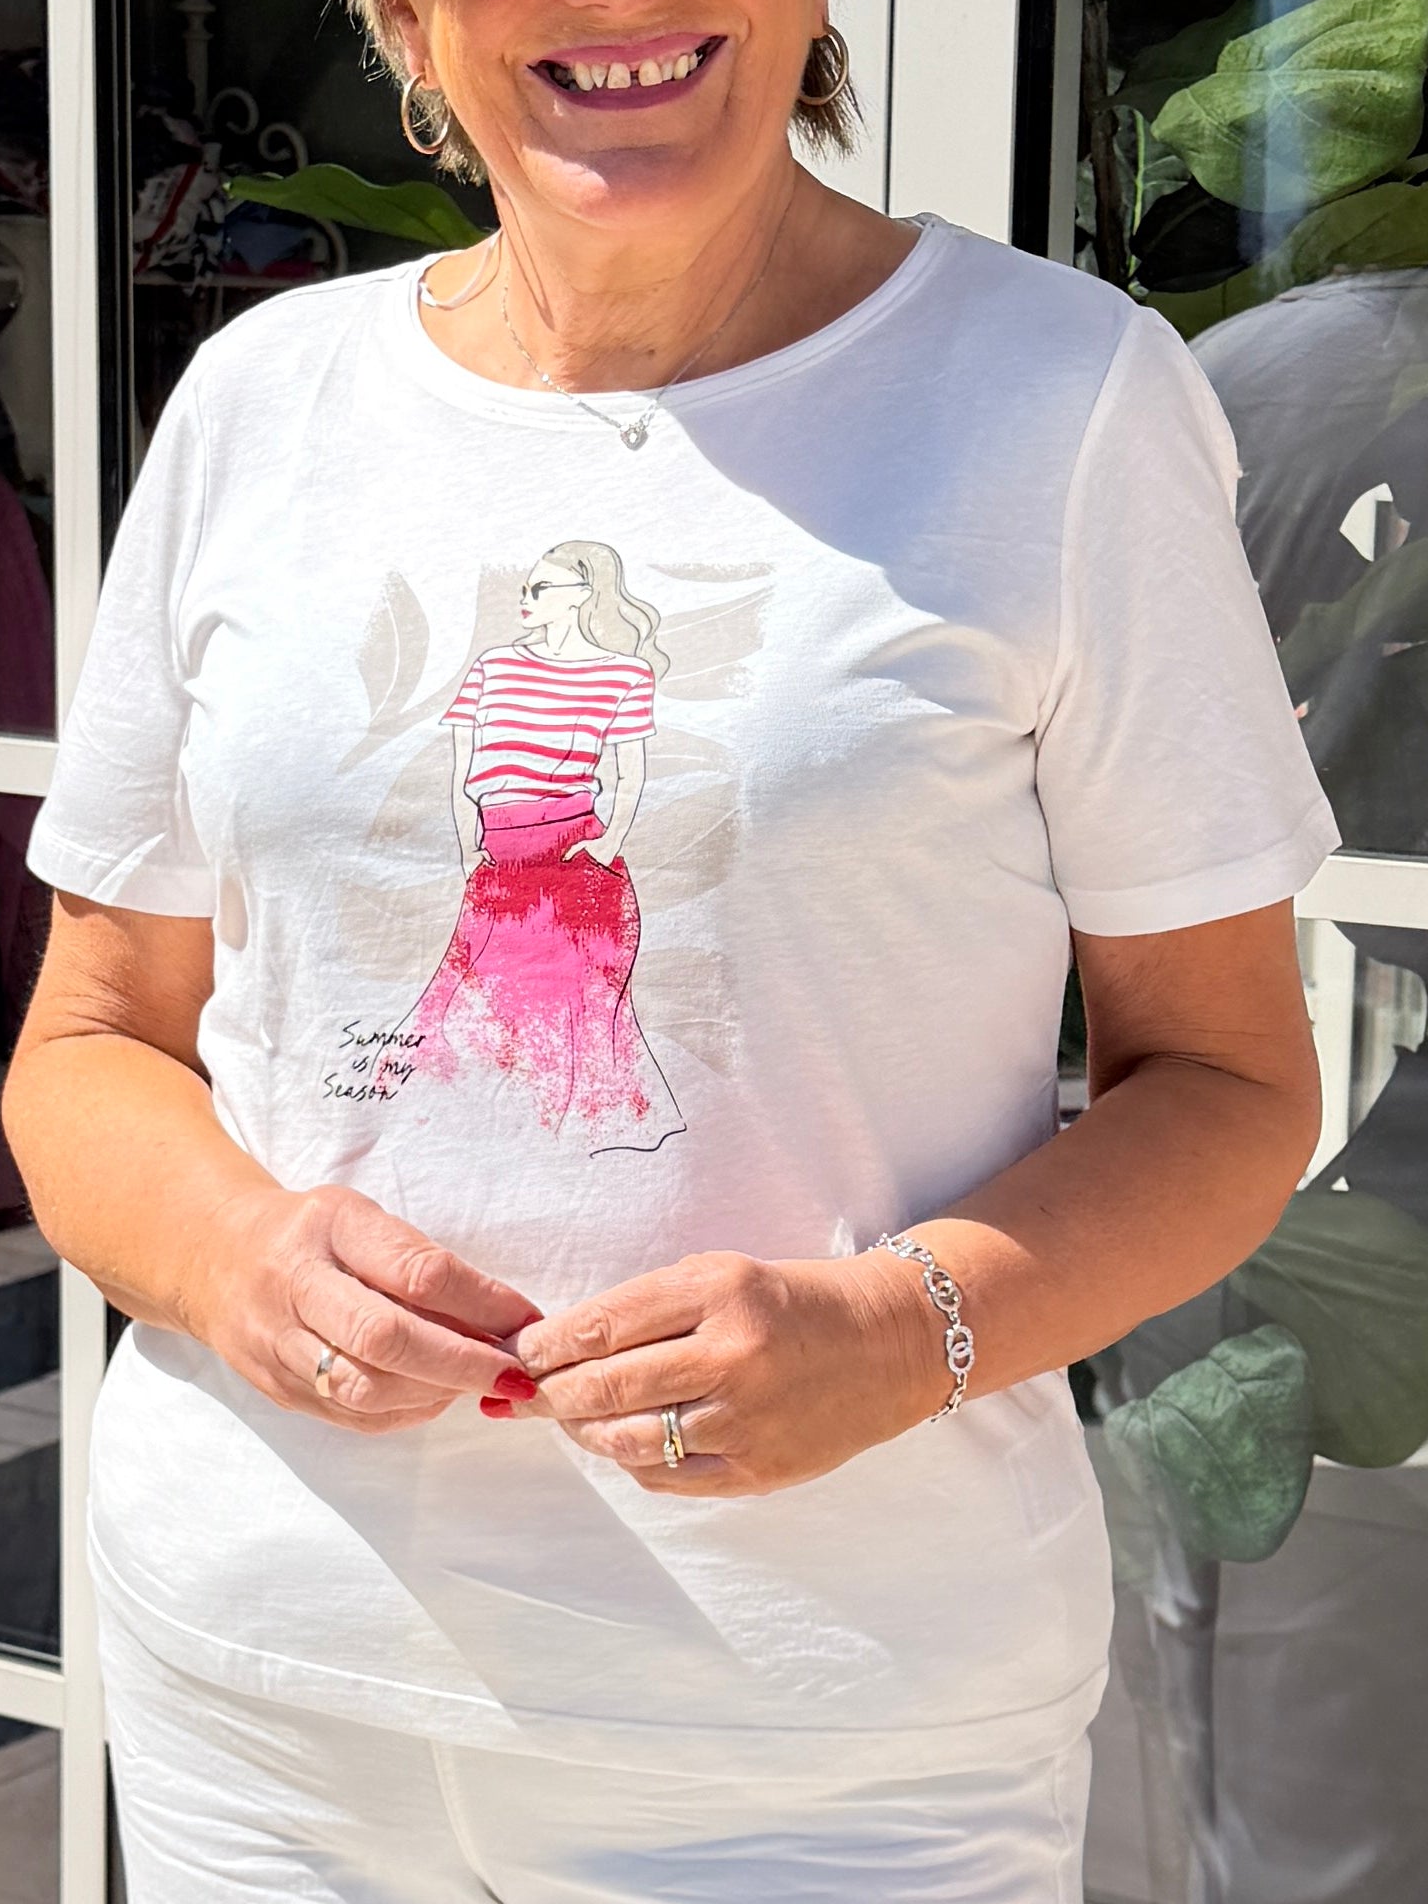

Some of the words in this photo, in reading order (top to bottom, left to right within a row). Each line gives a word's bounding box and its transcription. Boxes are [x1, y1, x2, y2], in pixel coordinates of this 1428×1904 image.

[339, 1020, 426, 1048] Summer
[352, 1055, 370, 1072] is
[381, 1060, 417, 1085] my
[323, 1073, 399, 1102] Season
